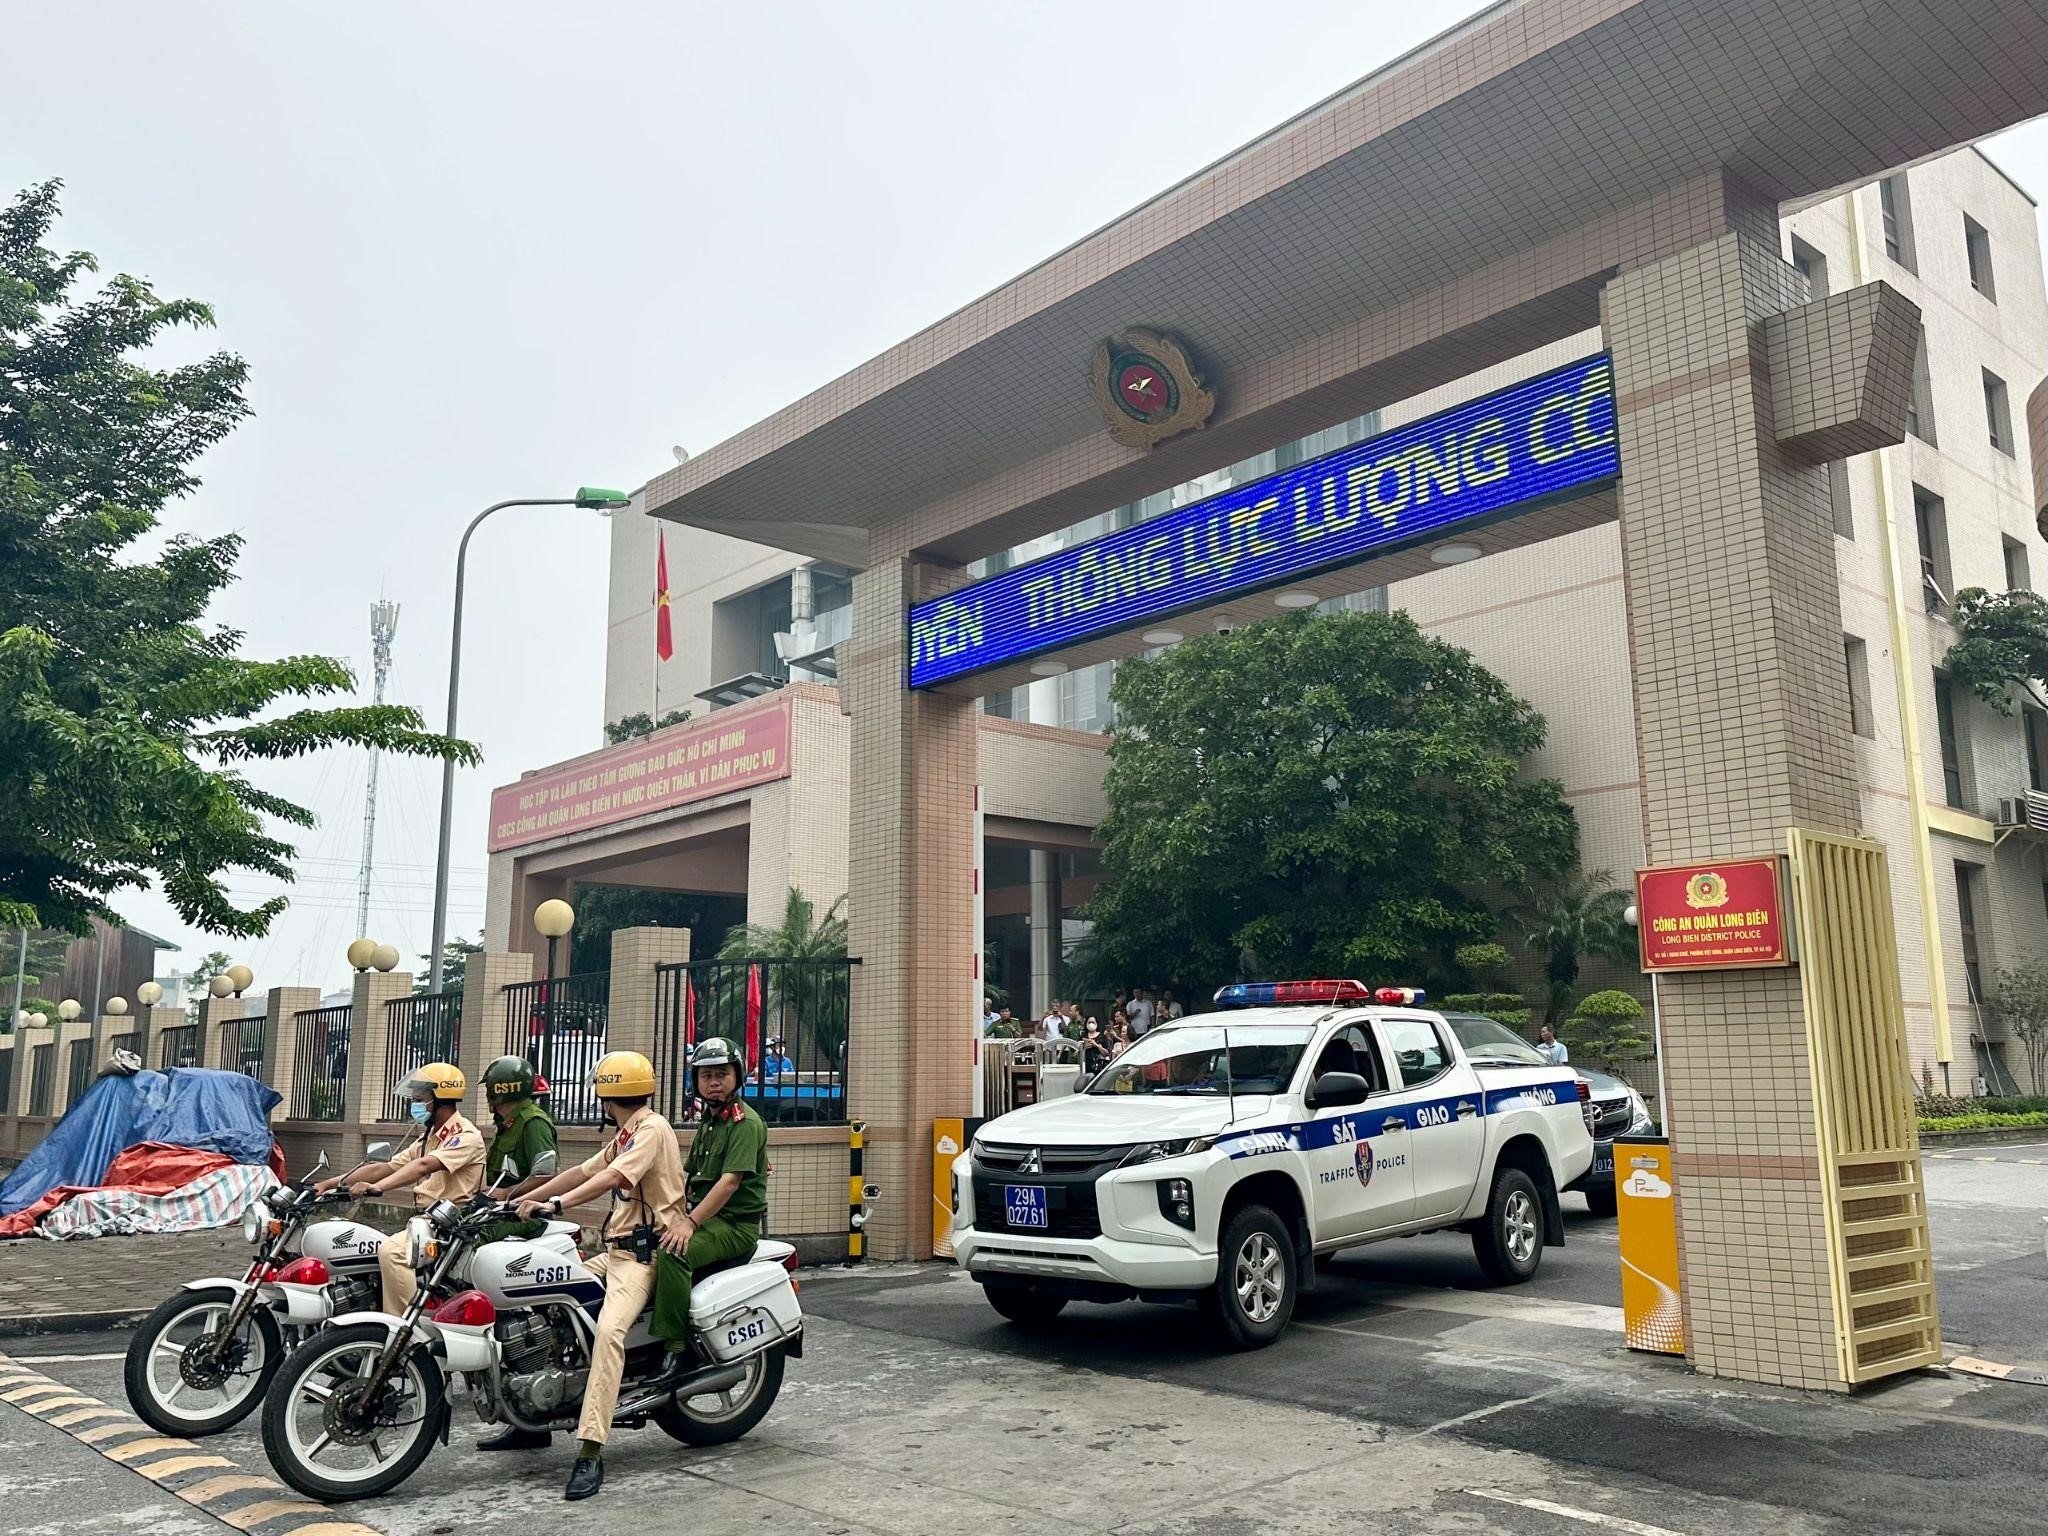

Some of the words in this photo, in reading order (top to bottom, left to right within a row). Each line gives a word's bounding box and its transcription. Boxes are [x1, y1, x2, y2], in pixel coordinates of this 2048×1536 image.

[1183, 497, 1280, 579] LỰC
[1294, 418, 1510, 542] LƯỢNG
[519, 794, 535, 812] HỌC
[535, 788, 549, 808] TẬP
[550, 786, 560, 801] VÀ
[561, 780, 578, 799] LÀM
[579, 774, 598, 793] THEO
[618, 761, 650, 781] GƯƠNG
[648, 754, 665, 776] ĐẠO
[667, 745, 685, 767] ĐỨC
[687, 741, 700, 762] HỒ
[702, 737, 718, 758] CHÍ
[720, 729, 746, 750] MINH
[497, 821, 515, 838] CBCS
[517, 815, 536, 833] CÔNG
[537, 812, 548, 829] AN
[549, 807, 568, 826] QUẬN
[571, 802, 591, 819] LONG
[592, 793, 611, 814] BIÊN
[612, 790, 620, 808] VÌ
[622, 782, 645, 805] NƯỚC
[647, 779, 669, 799] QUÊN
[700, 763, 709, 784] VÌ
[711, 761, 730, 781] DÂN
[733, 753, 760, 775] PHỤC
[762, 748, 775, 769] VỤ
[1652, 916, 1677, 932] CÔNG
[1679, 916, 1691, 930] AN
[1693, 913, 1718, 932] QUẬN
[1720, 912, 1744, 928] LONG
[1746, 909, 1769, 926] BIÊN
[1662, 935, 1681, 945] LONG
[1683, 933, 1700, 944] BIEN
[1701, 931, 1732, 943] DISTRICT
[1735, 929, 1761, 941] POLICE
[440, 1080, 464, 1088] CSGT
[494, 1081, 523, 1094] CSTT
[597, 1073, 622, 1084] CSGT
[1332, 1116, 1357, 1144] SÁT
[1416, 1104, 1450, 1127] GIAO
[1519, 1086, 1556, 1107] THÔNG
[1319, 1166, 1355, 1185] TRAFFIC
[1376, 1154, 1406, 1171] POLICE
[1014, 1188, 1037, 1206] 29A
[1008, 1206, 1045, 1226] 027.61
[505, 1270, 536, 1279] HONDA
[536, 1265, 573, 1284] CSGT
[727, 1319, 766, 1347] CSGT
